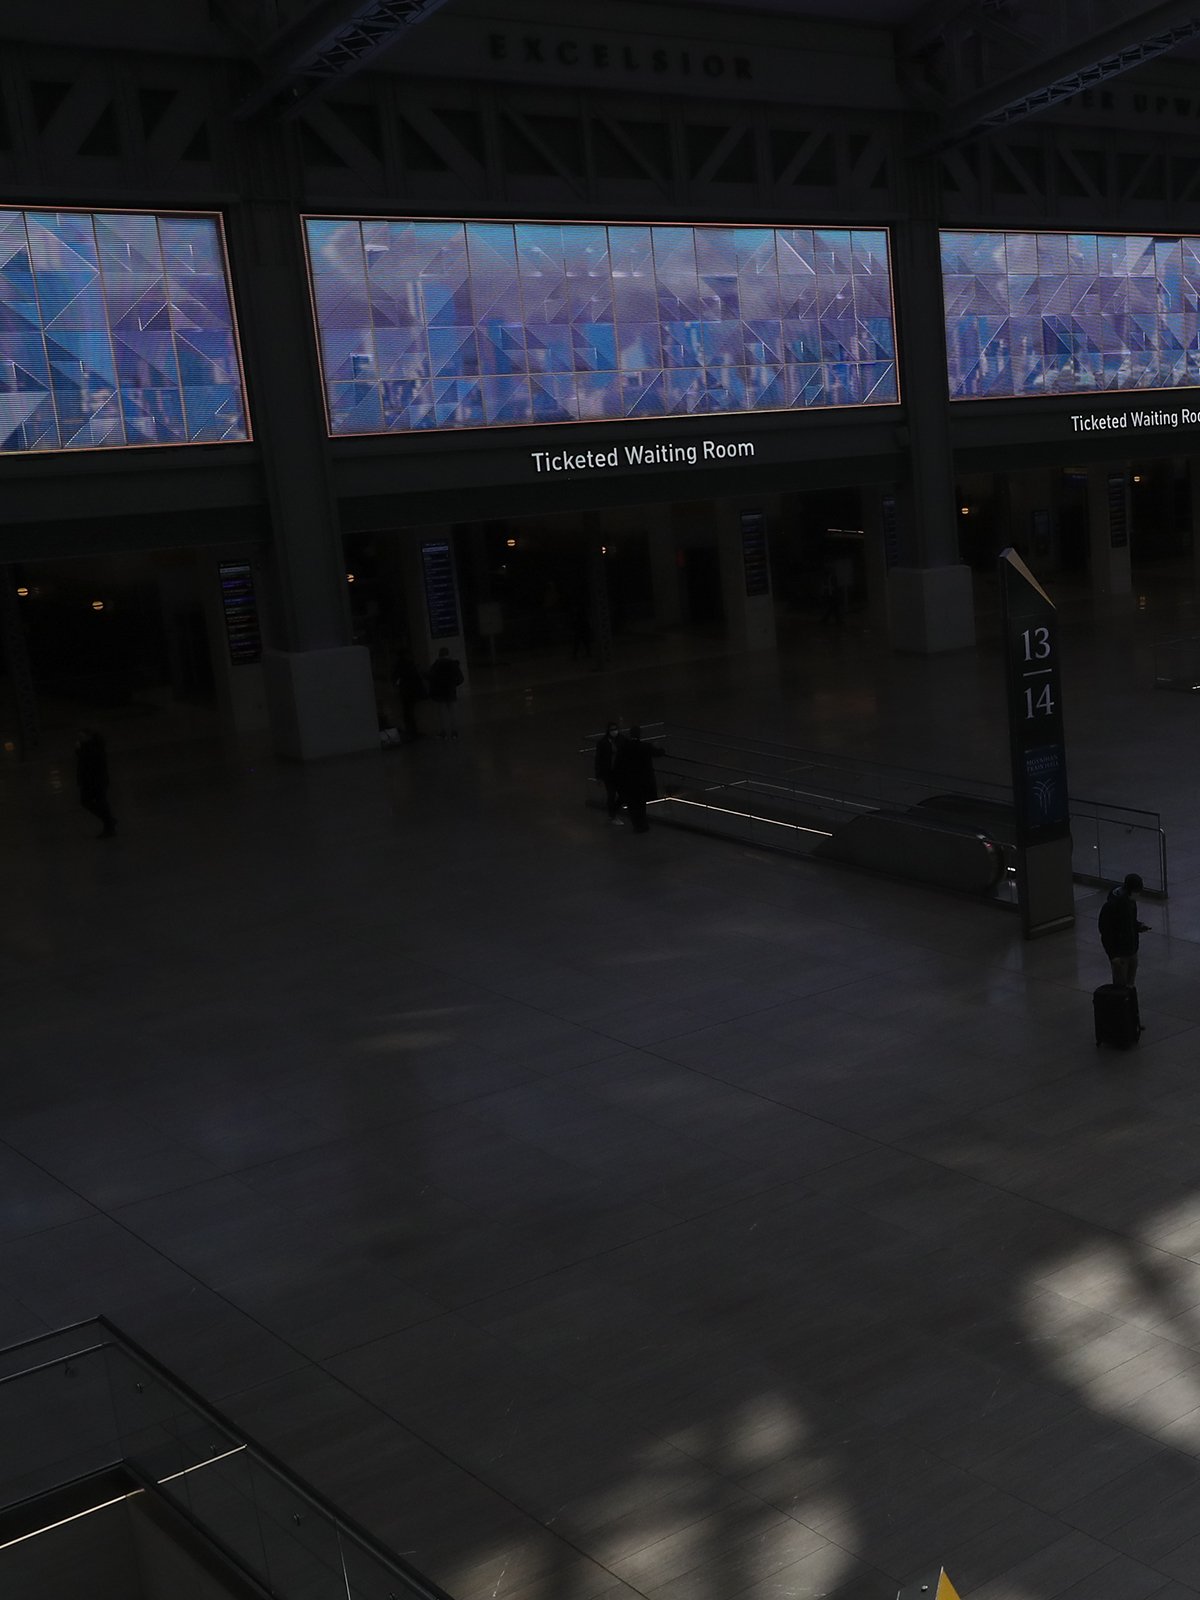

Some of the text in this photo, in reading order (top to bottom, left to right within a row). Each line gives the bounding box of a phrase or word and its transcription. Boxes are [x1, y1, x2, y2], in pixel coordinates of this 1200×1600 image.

[489, 34, 752, 80] EXCELSIOR
[1071, 413, 1127, 431] Ticketed
[1130, 410, 1178, 428] Waiting
[531, 440, 755, 472] Ticketed Waiting Room
[1020, 627, 1051, 662] 13
[1024, 683, 1055, 720] 14
